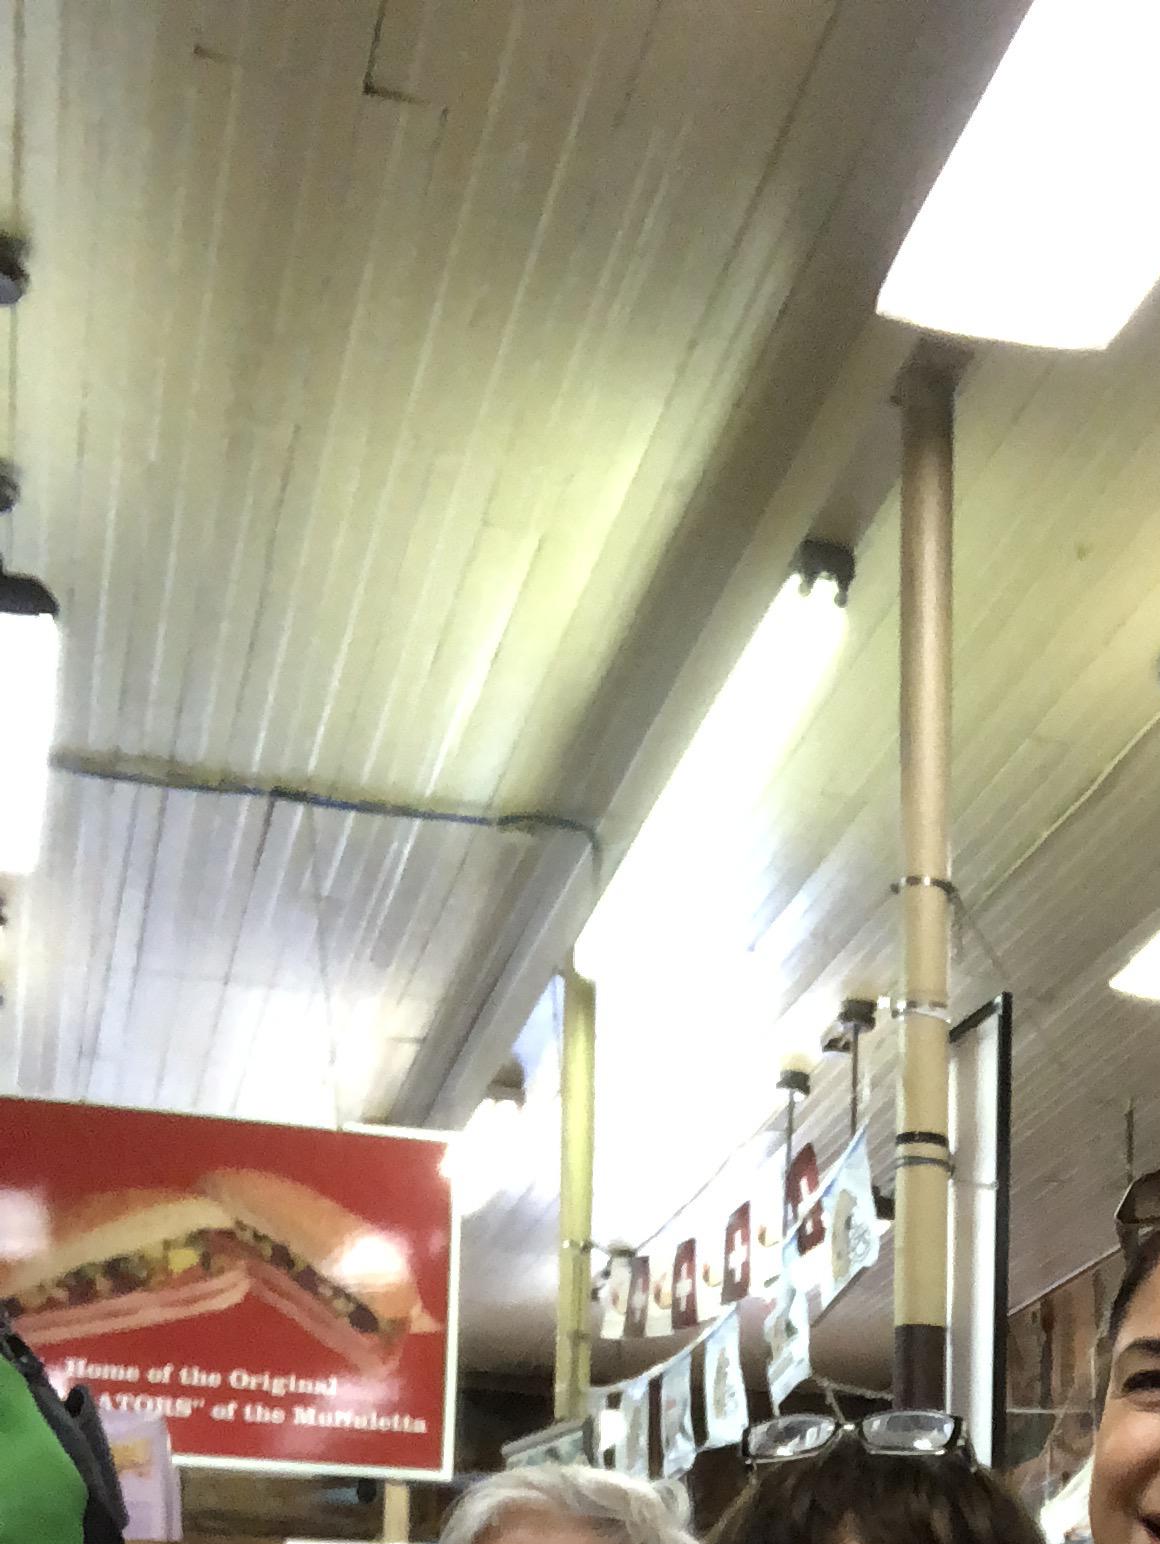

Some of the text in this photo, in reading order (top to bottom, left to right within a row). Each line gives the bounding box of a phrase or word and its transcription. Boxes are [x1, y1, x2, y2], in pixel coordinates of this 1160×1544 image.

[65, 1357, 339, 1398] Home of the Original
[211, 1400, 238, 1421] of
[243, 1402, 286, 1424] the
